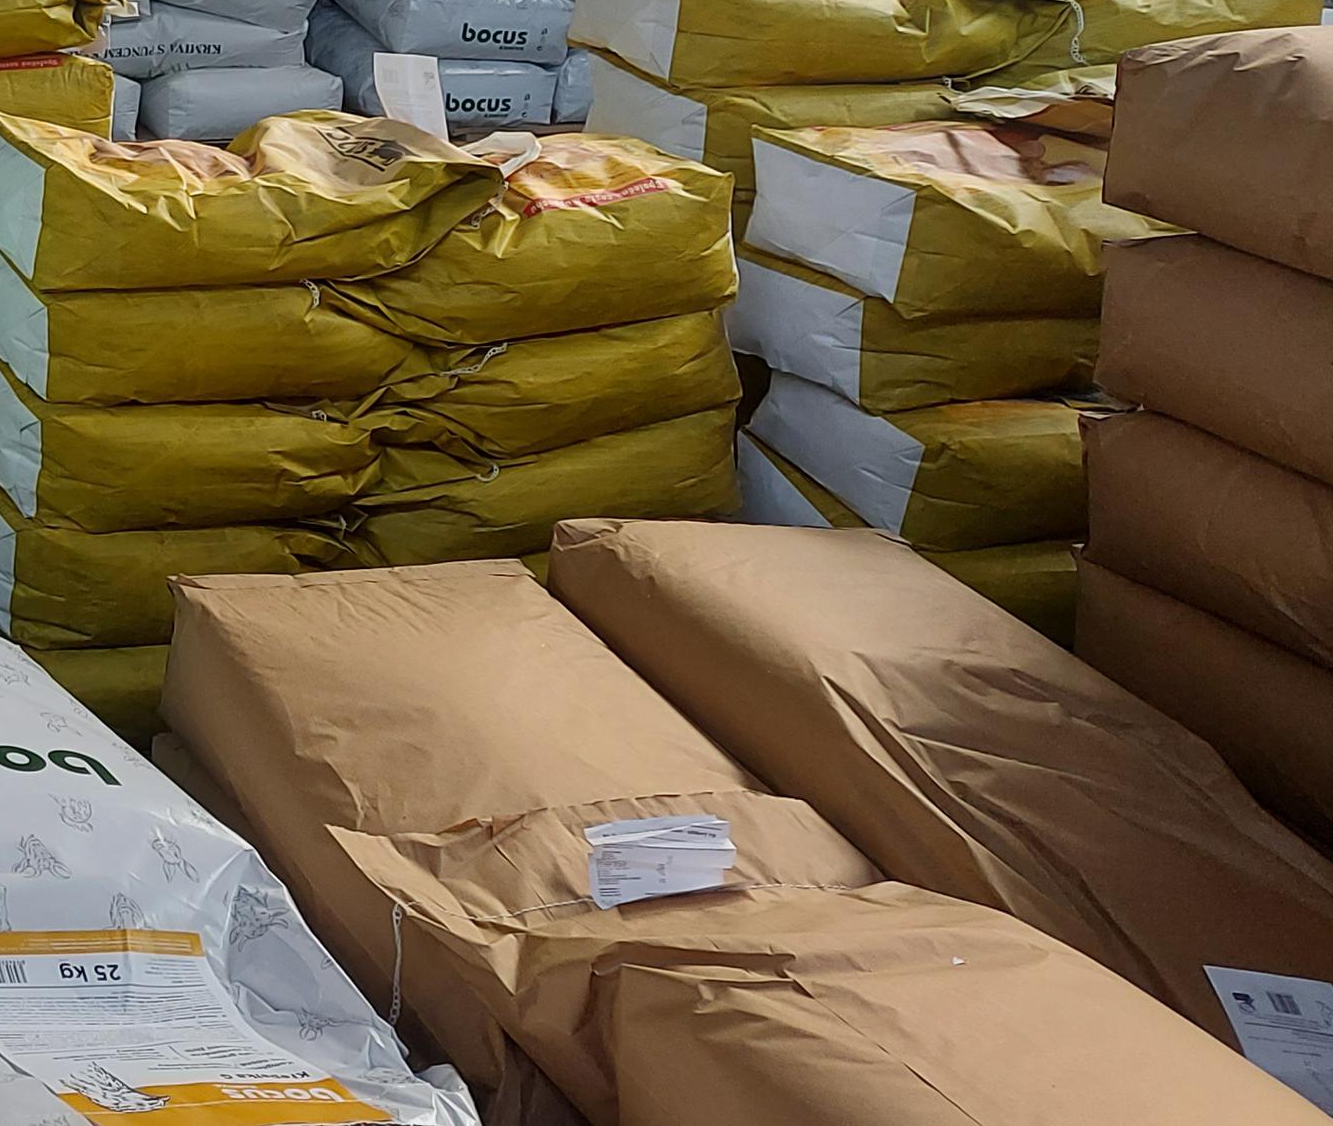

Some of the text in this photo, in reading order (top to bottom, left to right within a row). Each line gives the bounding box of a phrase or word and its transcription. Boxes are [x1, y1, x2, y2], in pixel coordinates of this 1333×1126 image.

[462, 23, 527, 45] bocus
[169, 43, 221, 55] KRMIVA
[446, 94, 511, 112] bocus
[58, 963, 122, 983] 25 kg
